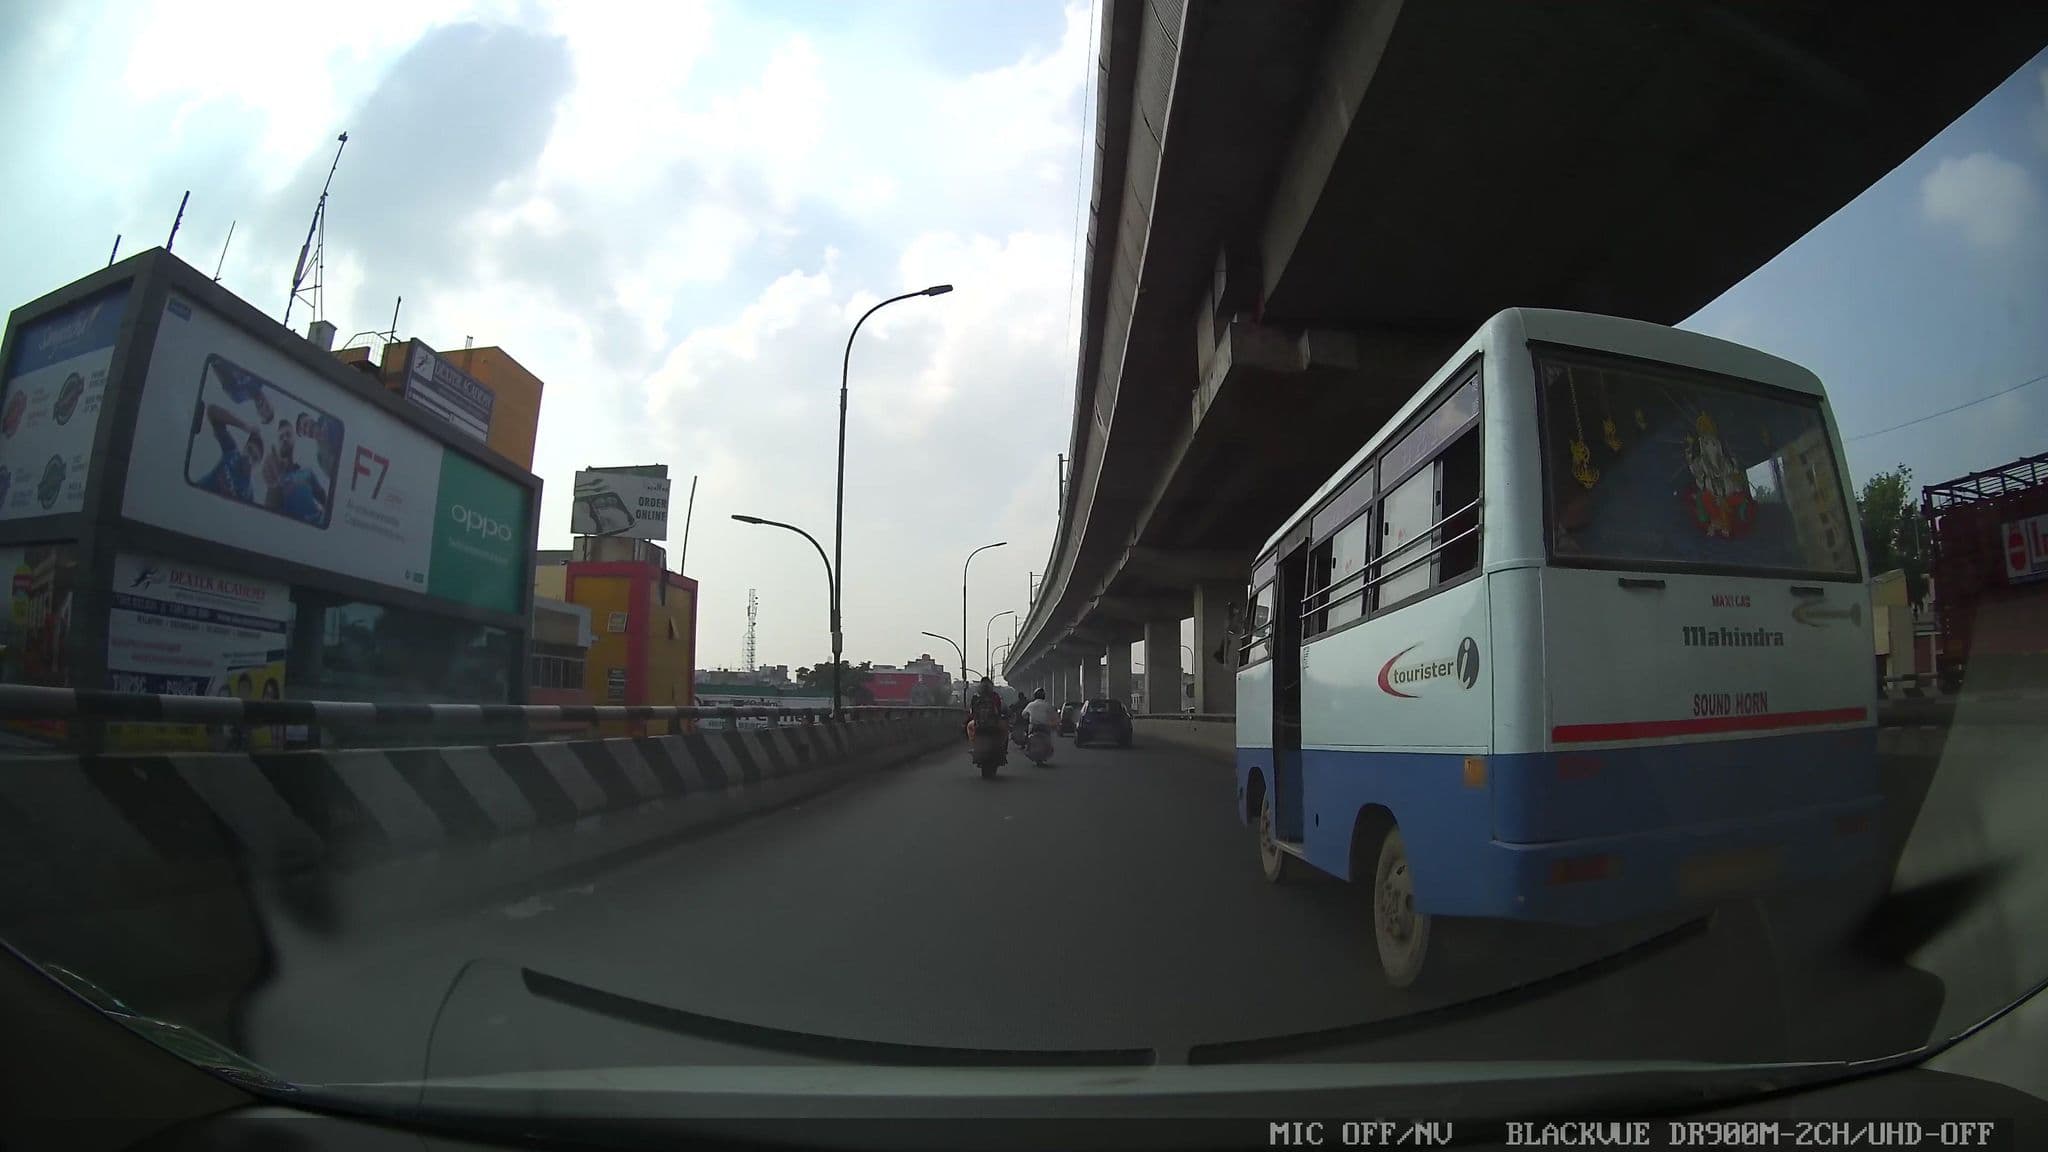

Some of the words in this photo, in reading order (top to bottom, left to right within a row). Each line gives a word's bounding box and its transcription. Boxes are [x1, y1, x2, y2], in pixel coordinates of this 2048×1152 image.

[352, 445, 389, 500] F7
[451, 503, 513, 542] oppo
[1682, 626, 1784, 647] Mahindra
[1393, 660, 1454, 685] tourister
[1693, 693, 1731, 717] SOUND
[1735, 690, 1768, 714] HORN
